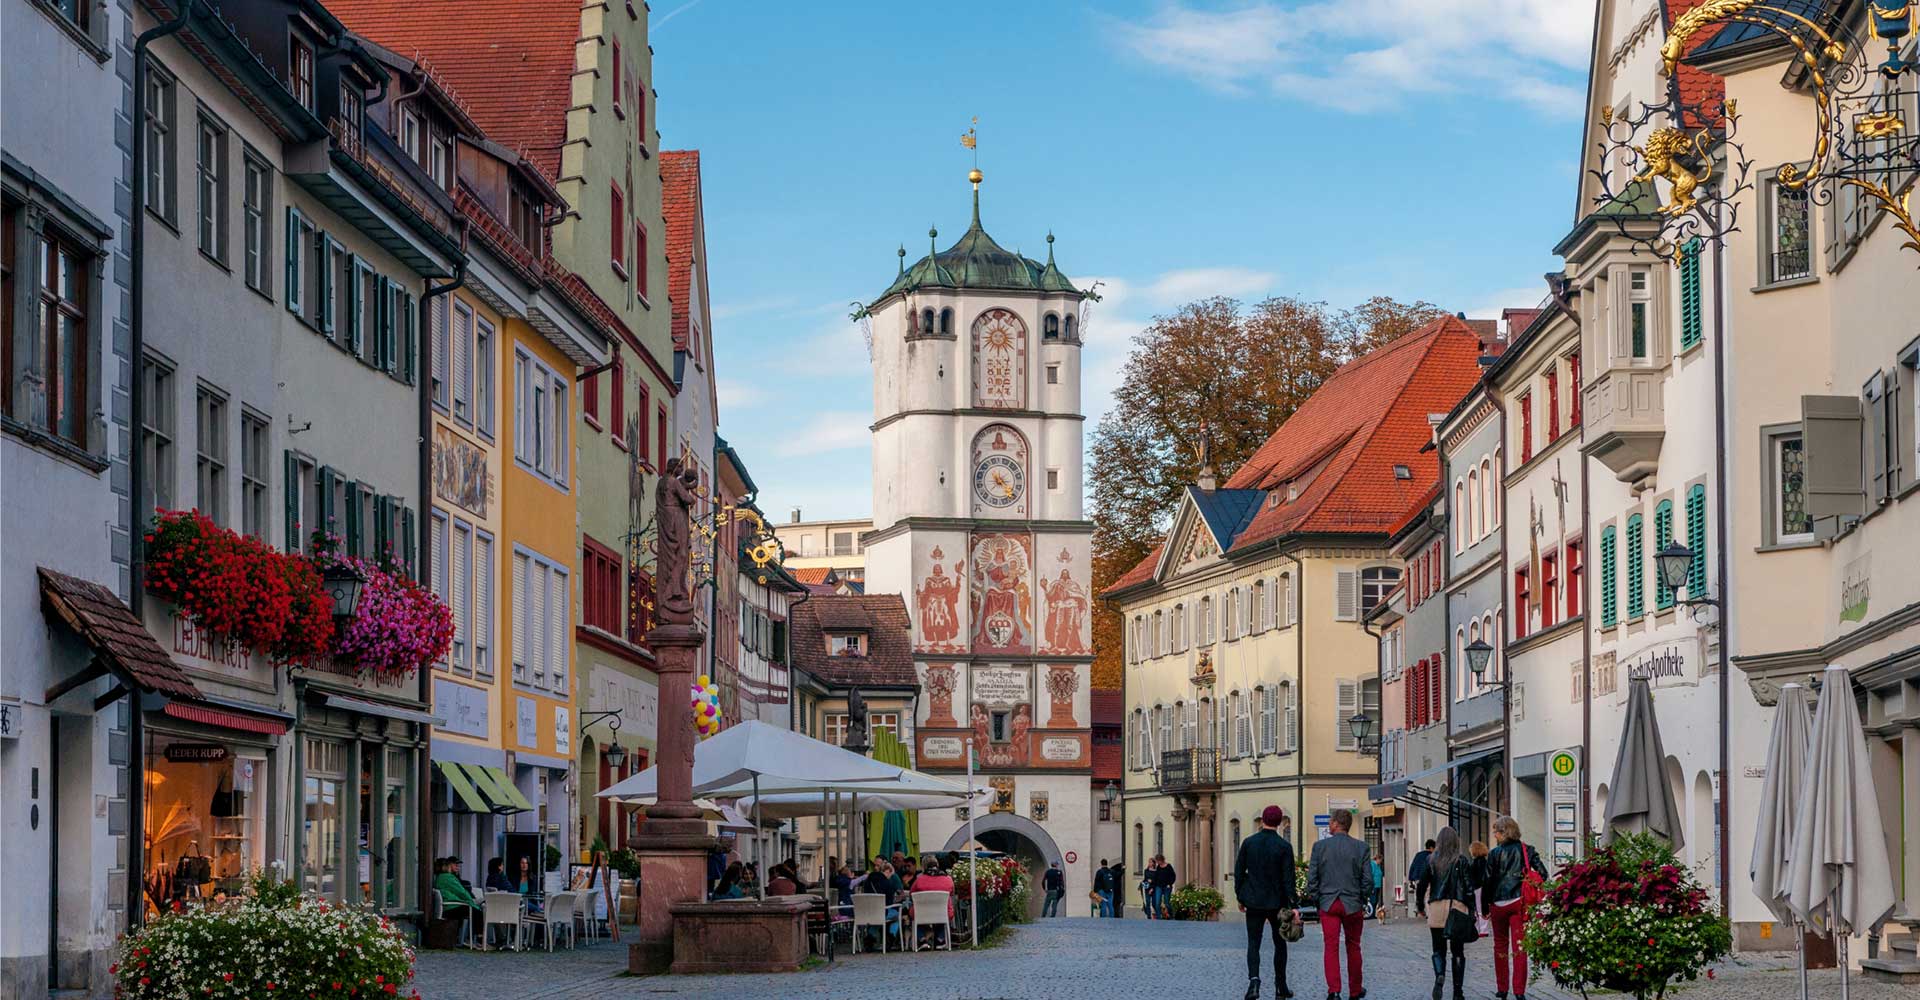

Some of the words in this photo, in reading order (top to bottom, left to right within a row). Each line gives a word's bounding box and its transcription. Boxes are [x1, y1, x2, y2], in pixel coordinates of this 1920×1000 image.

[170, 748, 199, 758] LEDER
[200, 748, 224, 758] RUPP
[1558, 759, 1569, 772] H
